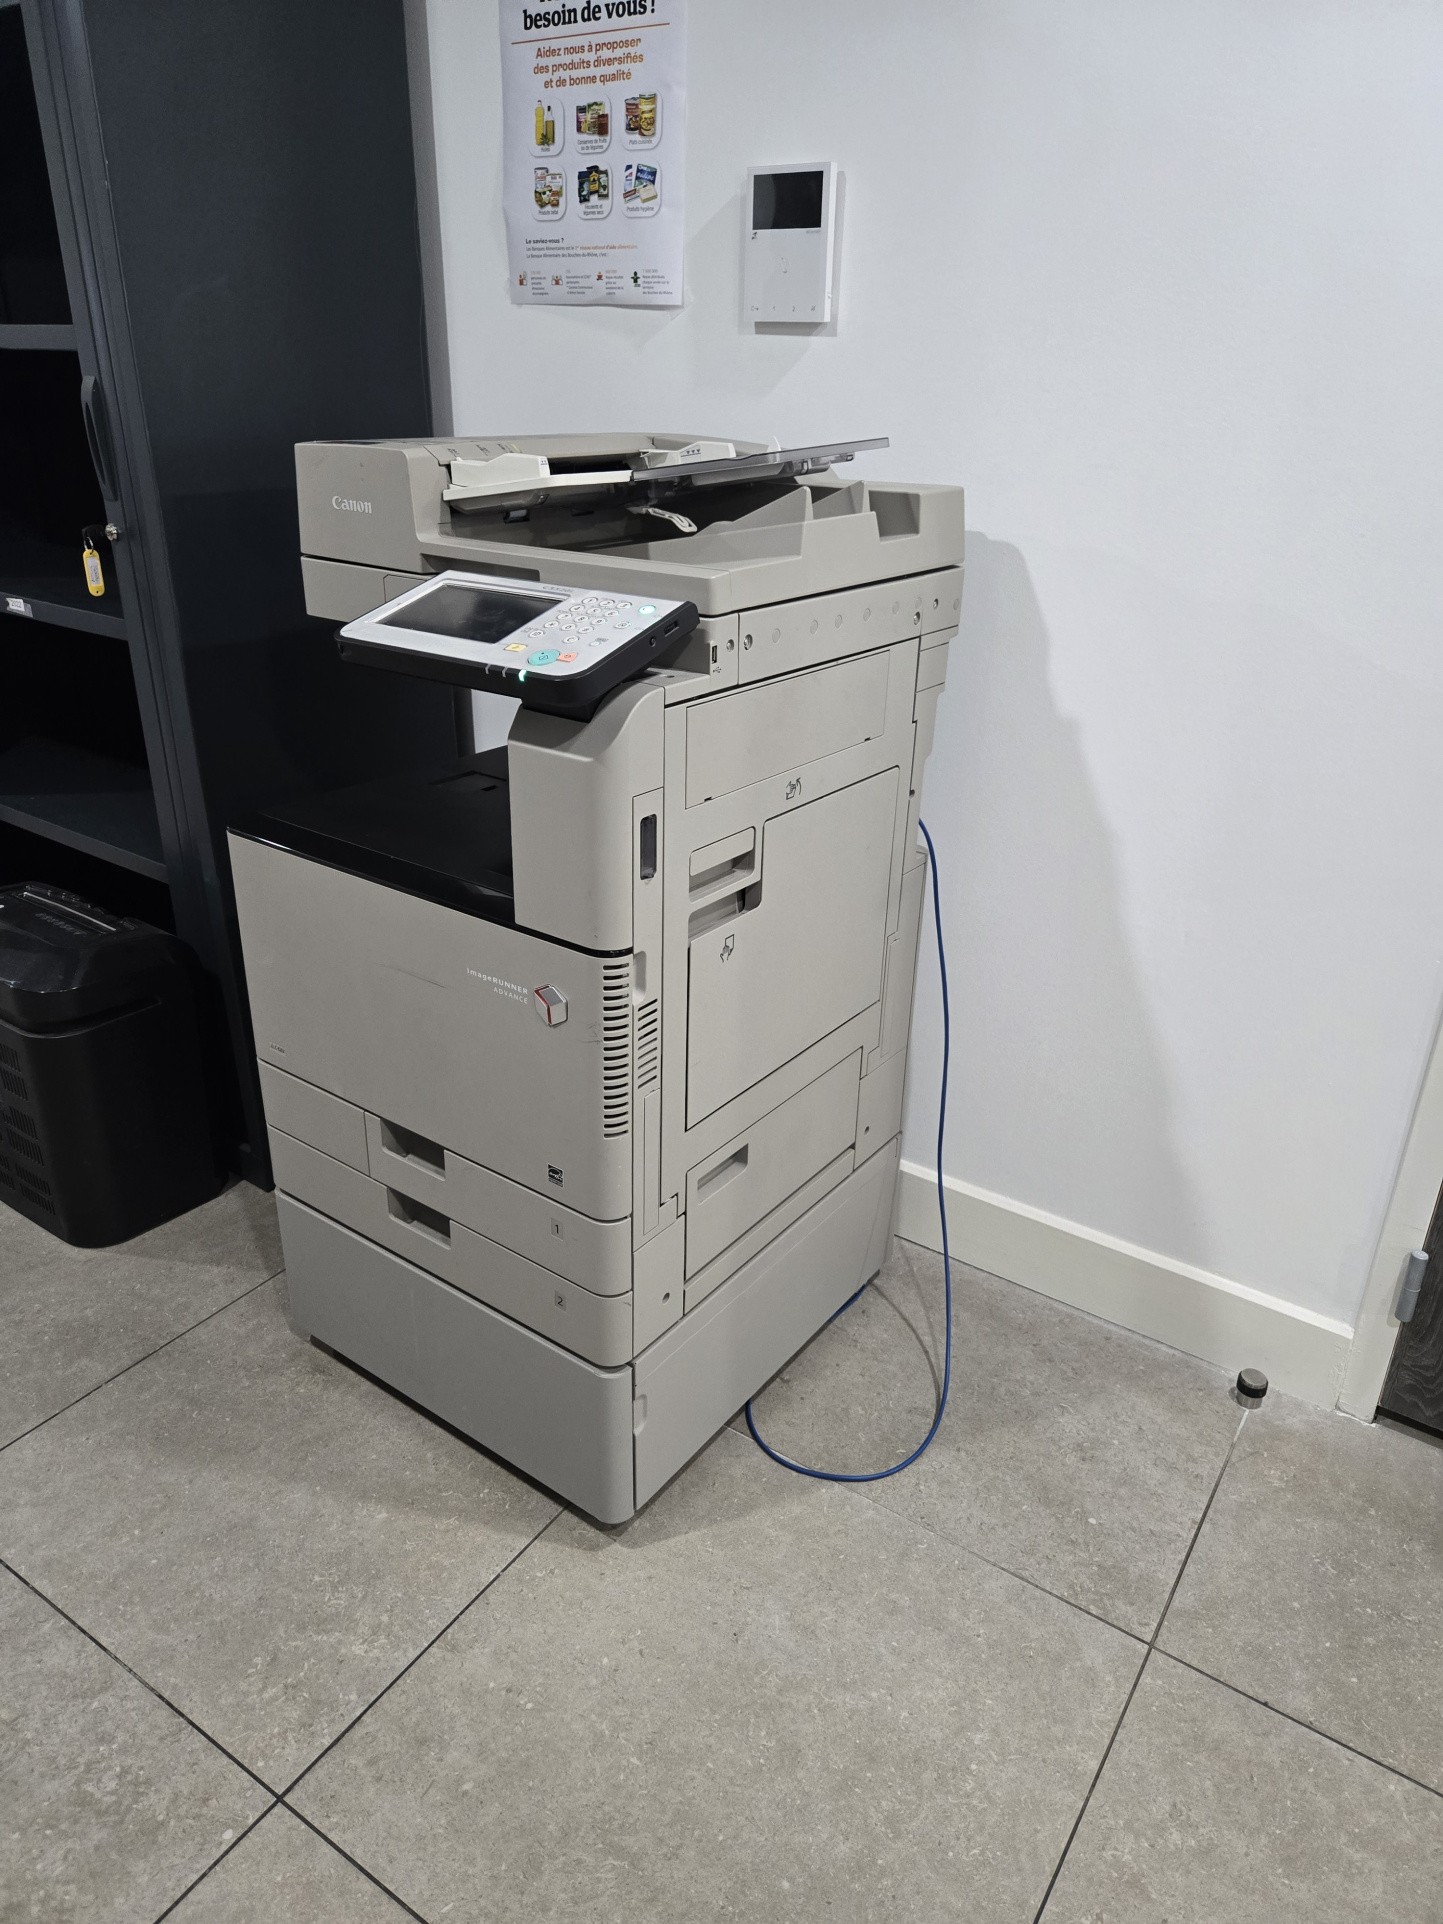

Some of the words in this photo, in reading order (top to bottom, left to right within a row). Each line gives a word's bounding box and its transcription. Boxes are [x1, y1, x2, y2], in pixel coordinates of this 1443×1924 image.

[522, 4, 578, 30] besoin
[580, 0, 602, 22] de
[604, 0, 648, 19] vous
[536, 46, 562, 59] Aidez
[564, 44, 586, 56] nous
[587, 41, 593, 53] à
[595, 37, 642, 55] proposer
[534, 64, 550, 74] des
[552, 58, 591, 76] produits
[593, 52, 644, 68] diversifiés
[544, 78, 554, 89] et
[556, 76, 567, 88] de
[569, 74, 597, 86] bonne
[599, 68, 632, 86] qualité
[332, 495, 372, 514] Canon
[466, 968, 528, 994] imageRUNNER
[493, 986, 528, 1004] ADVANCE
[555, 1224, 559, 1234] 1
[557, 1296, 563, 1307] 2
